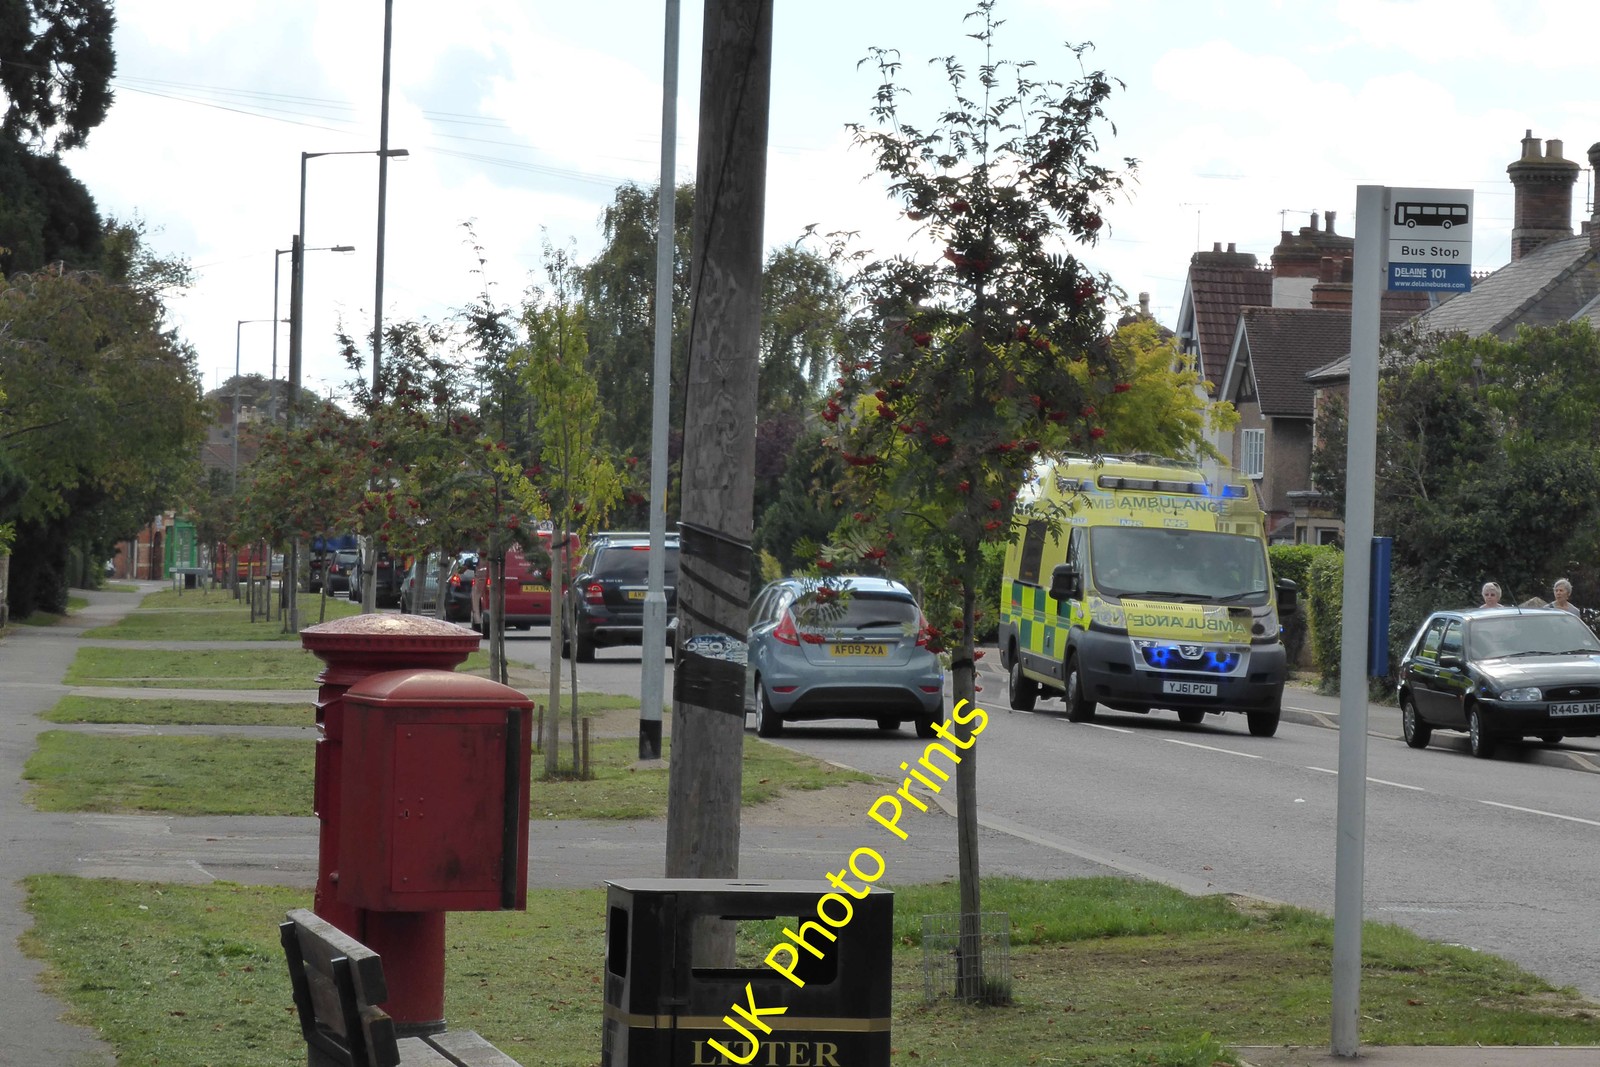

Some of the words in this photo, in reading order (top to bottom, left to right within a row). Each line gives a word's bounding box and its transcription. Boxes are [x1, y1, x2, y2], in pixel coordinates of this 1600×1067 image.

[1401, 246, 1425, 256] Bus
[1430, 246, 1460, 259] Stop
[1394, 267, 1427, 278] DELAINE
[1431, 268, 1446, 279] 101
[1120, 496, 1230, 513] AMBULANCE
[1120, 519, 1144, 527] NHS
[1164, 518, 1188, 528] NHS
[834, 645, 862, 655] AF09
[864, 645, 884, 655] ZXA
[1169, 682, 1191, 694] YJ61
[1192, 684, 1212, 695] PGU
[1551, 705, 1579, 715] R446
